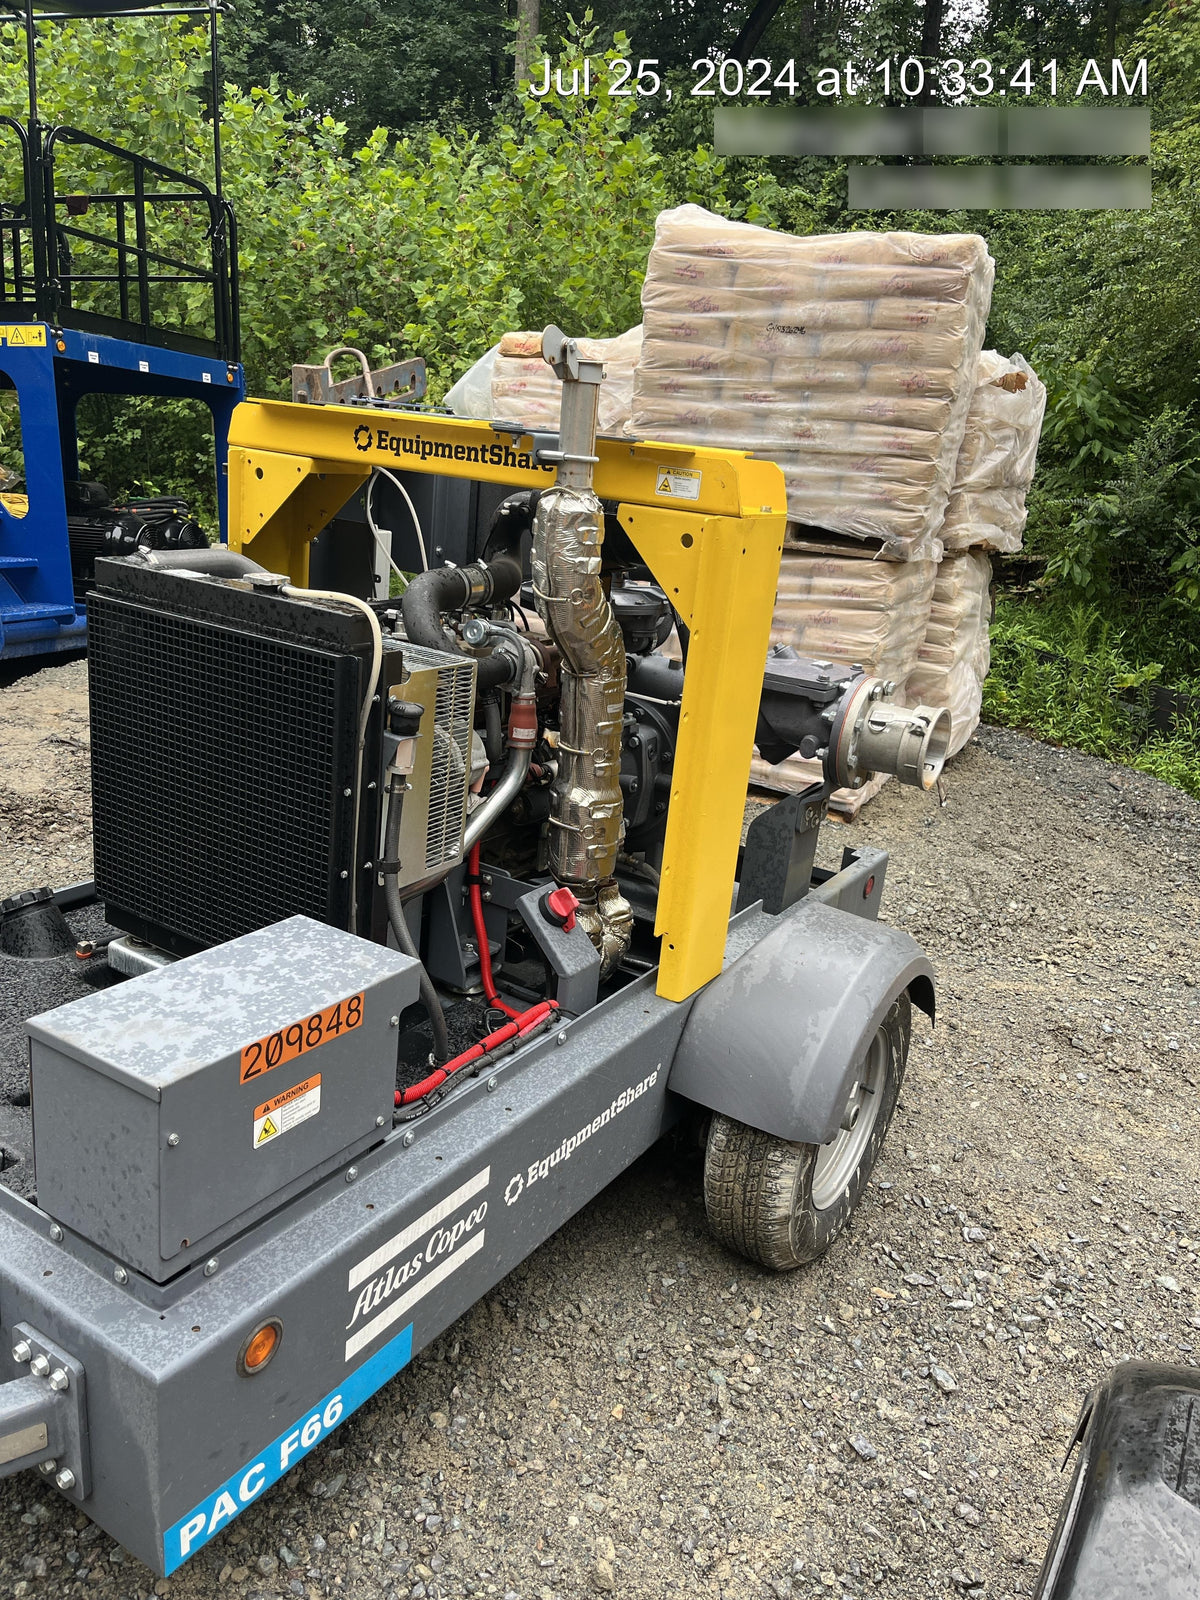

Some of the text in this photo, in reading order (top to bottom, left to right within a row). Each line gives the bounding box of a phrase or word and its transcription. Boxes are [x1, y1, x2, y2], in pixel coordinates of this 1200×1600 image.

[376, 429, 554, 472] EquipmentSha
[243, 995, 361, 1080] 209848
[273, 1082, 309, 1106] WARNING
[346, 1201, 488, 1330] Atlas Copco
[179, 1394, 343, 1557] PAC F66
